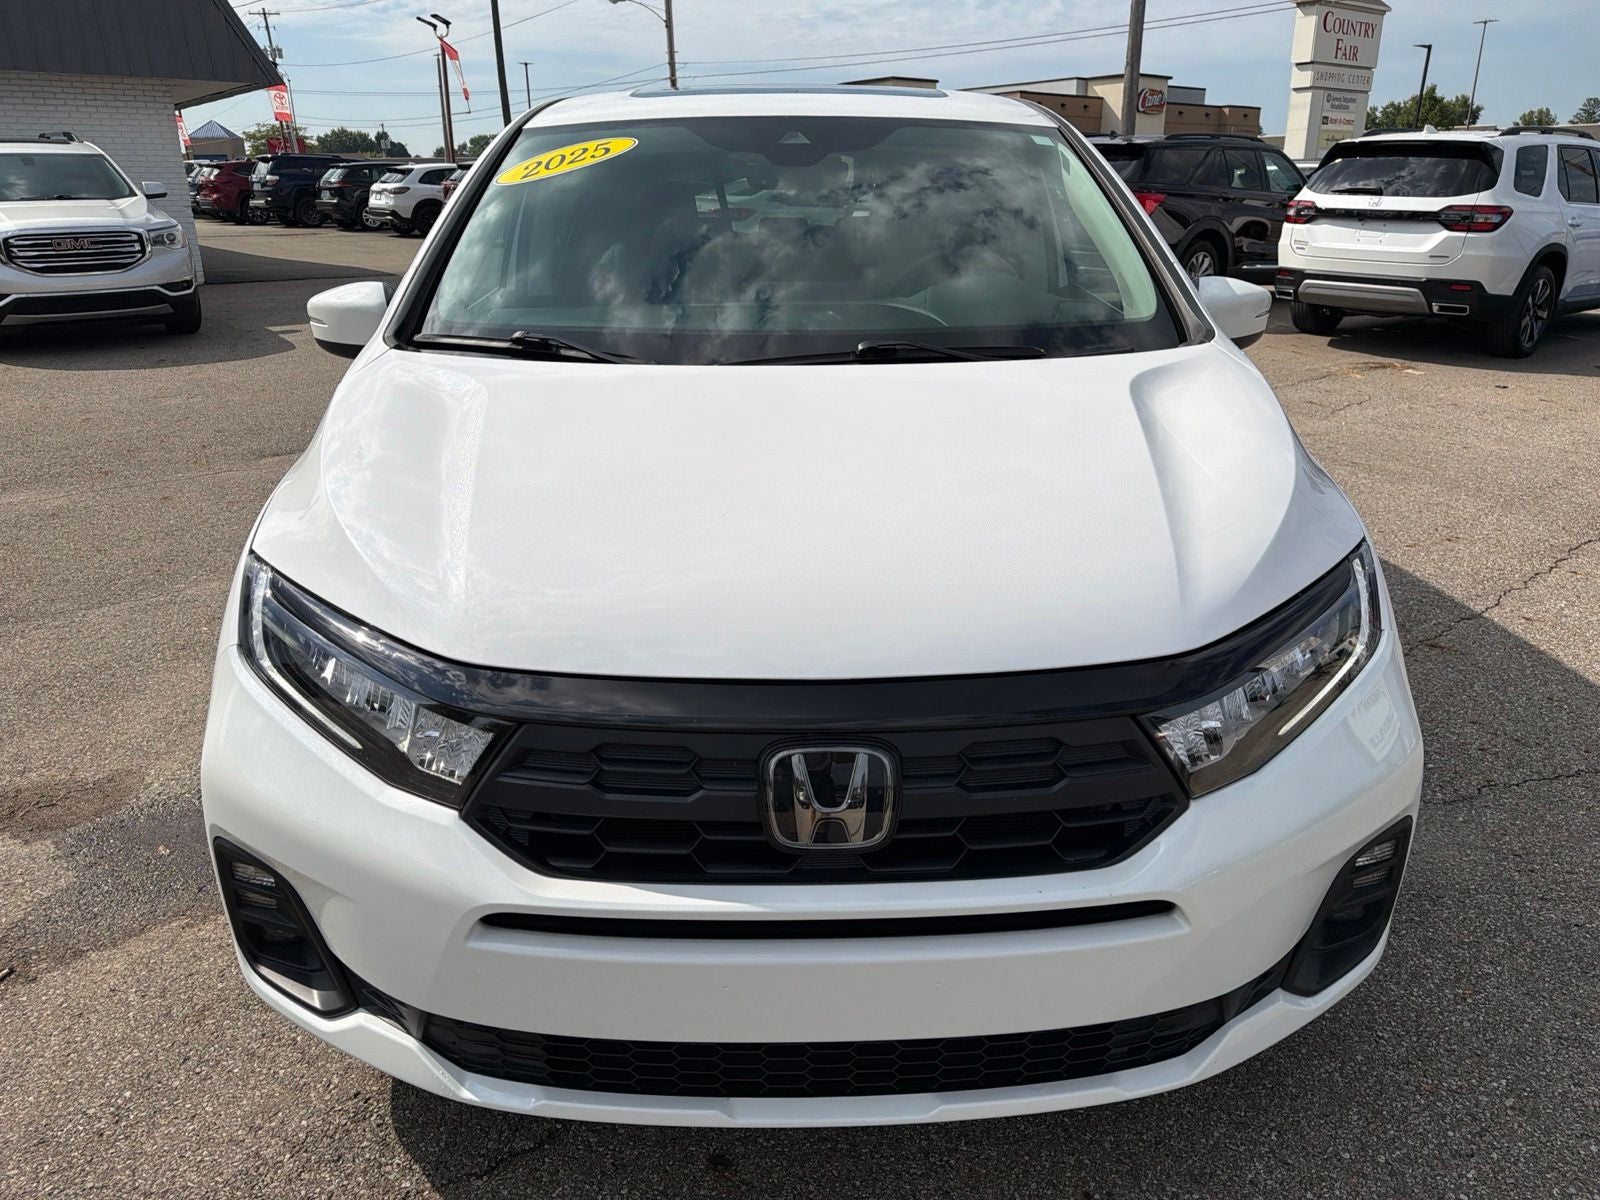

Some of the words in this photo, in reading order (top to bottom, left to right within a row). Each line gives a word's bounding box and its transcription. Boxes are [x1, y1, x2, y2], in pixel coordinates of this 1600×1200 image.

[1334, 38, 1359, 62] FAIR
[1316, 71, 1345, 83] SHOPPING
[1348, 74, 1370, 86] CENTER
[519, 141, 613, 180] 2025
[53, 238, 102, 250] GMC
